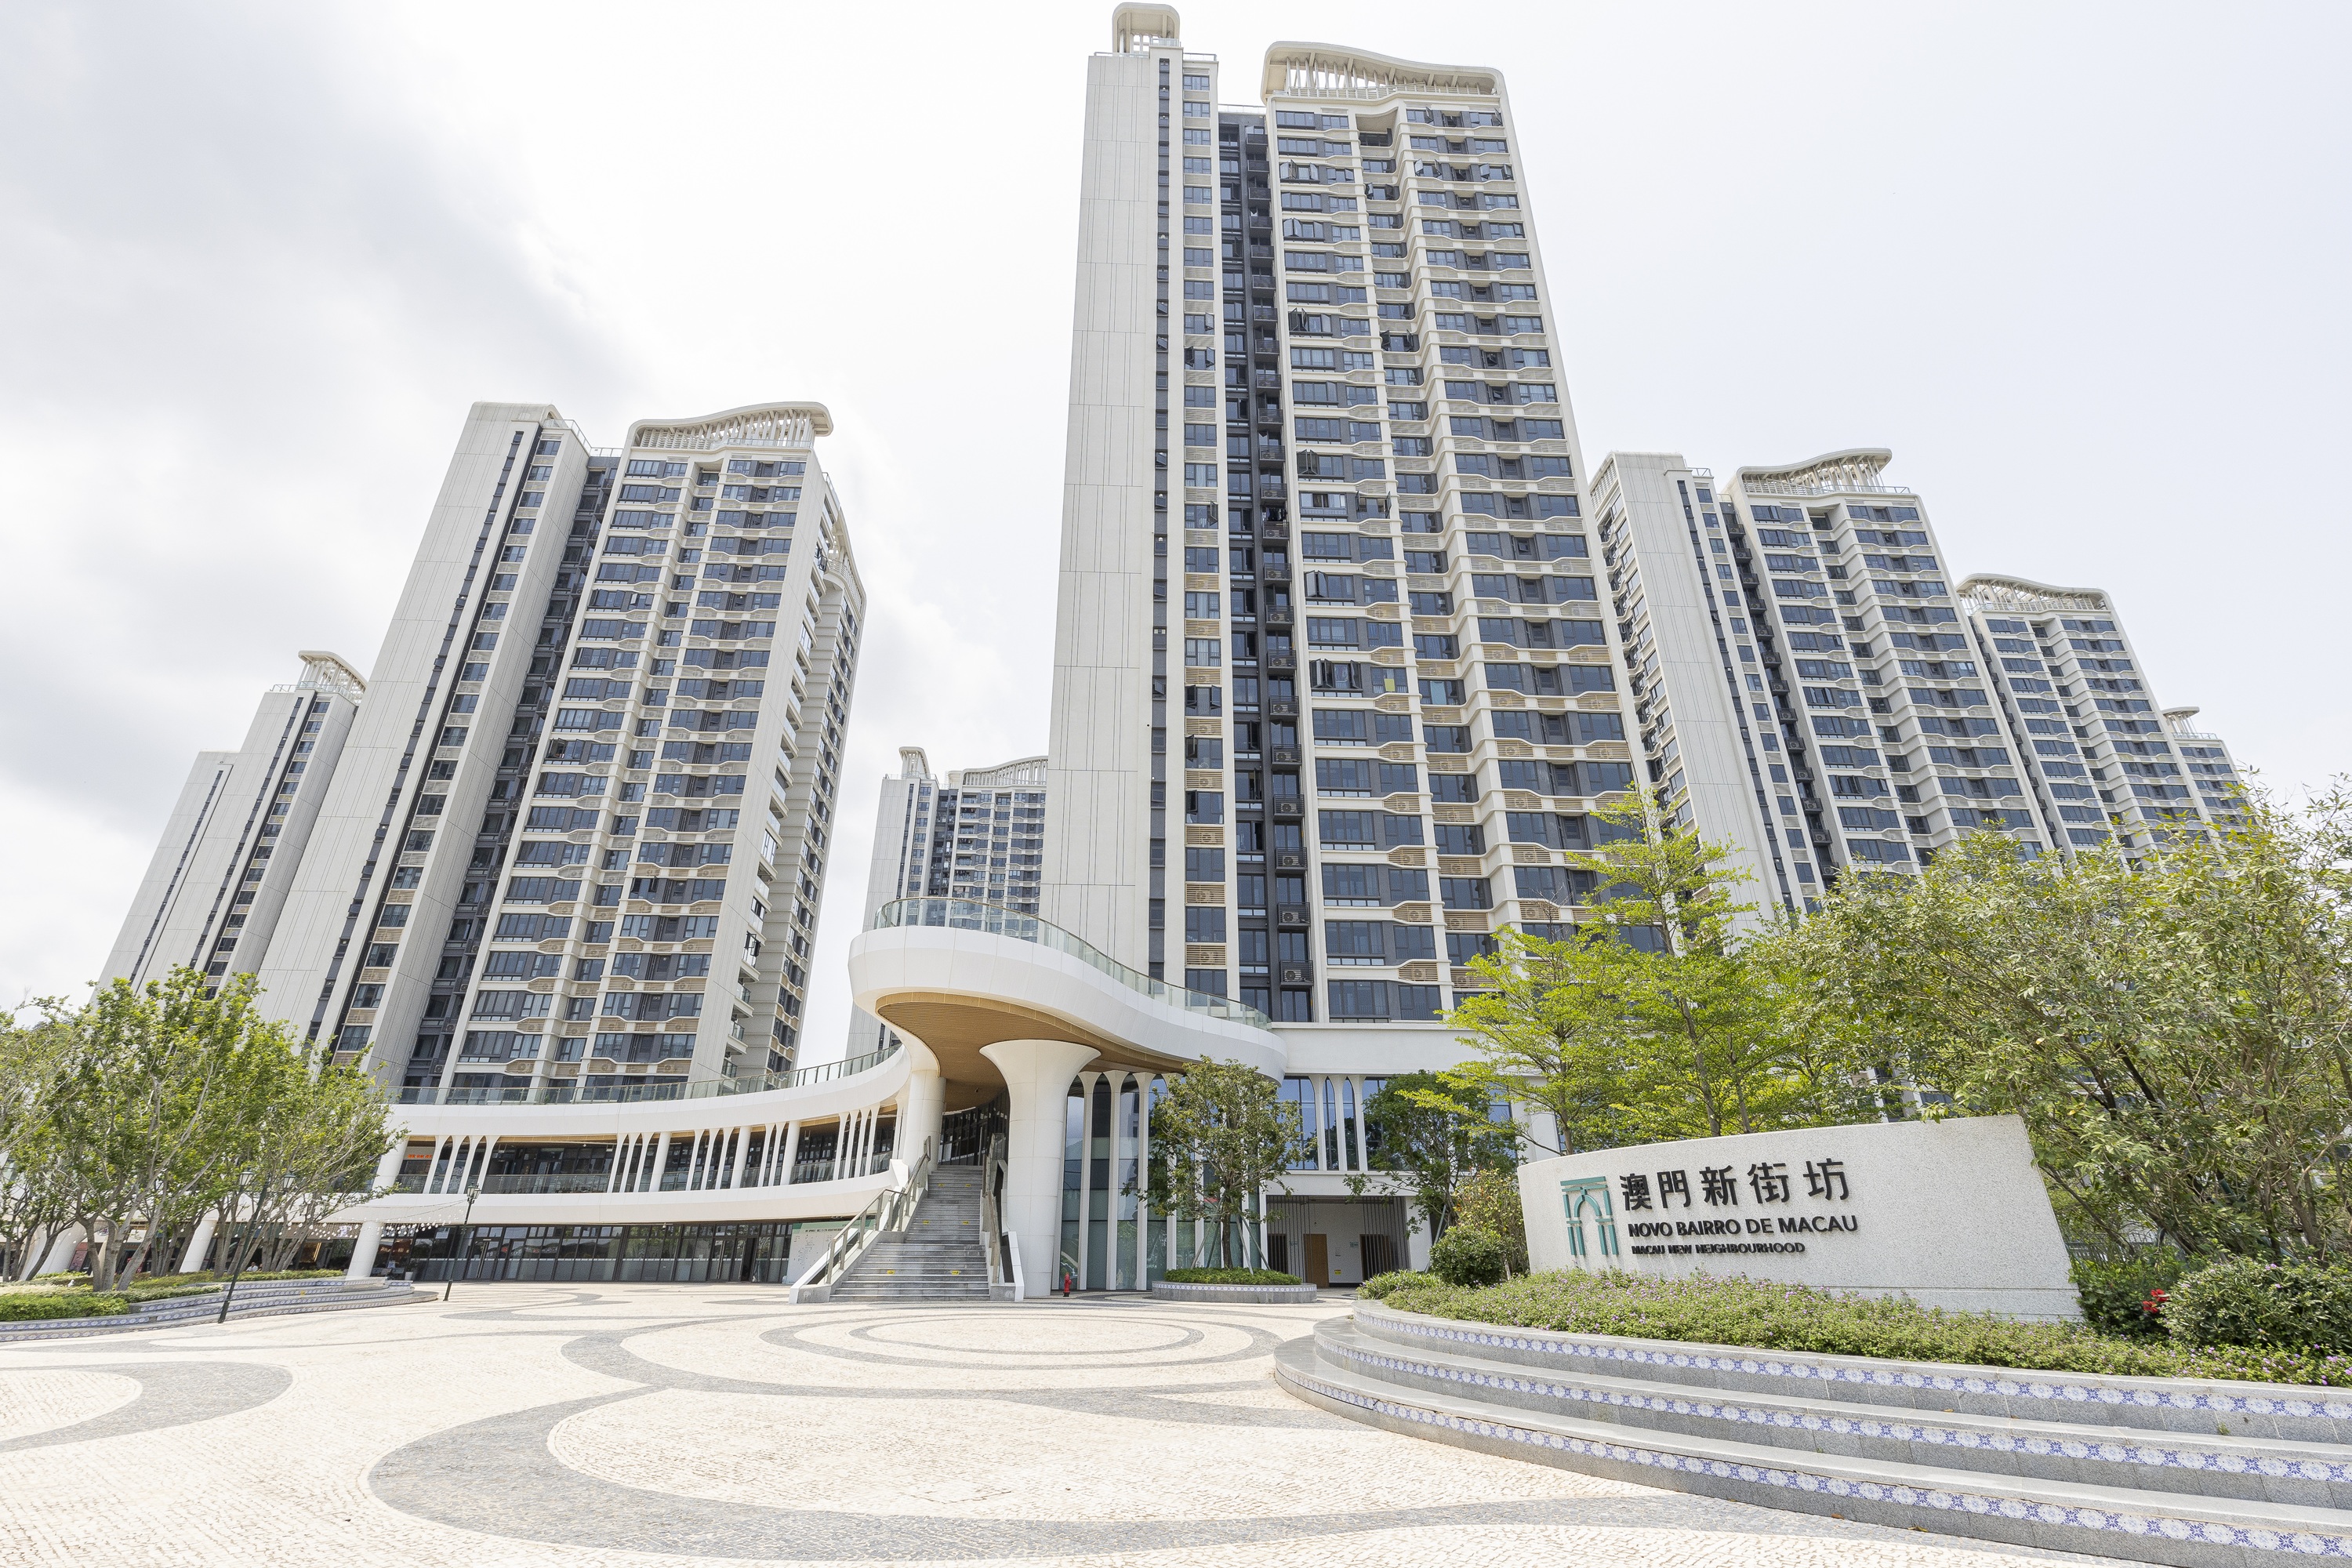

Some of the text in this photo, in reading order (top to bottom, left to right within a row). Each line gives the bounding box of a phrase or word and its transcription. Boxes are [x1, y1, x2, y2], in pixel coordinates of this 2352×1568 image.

[1620, 1158, 1849, 1210] 澳門新街坊
[1628, 1215, 1858, 1236] NOVO BAIRRO DE MACAU
[1632, 1243, 1806, 1254] MACAU NEW NEIGHBOURHOOD
